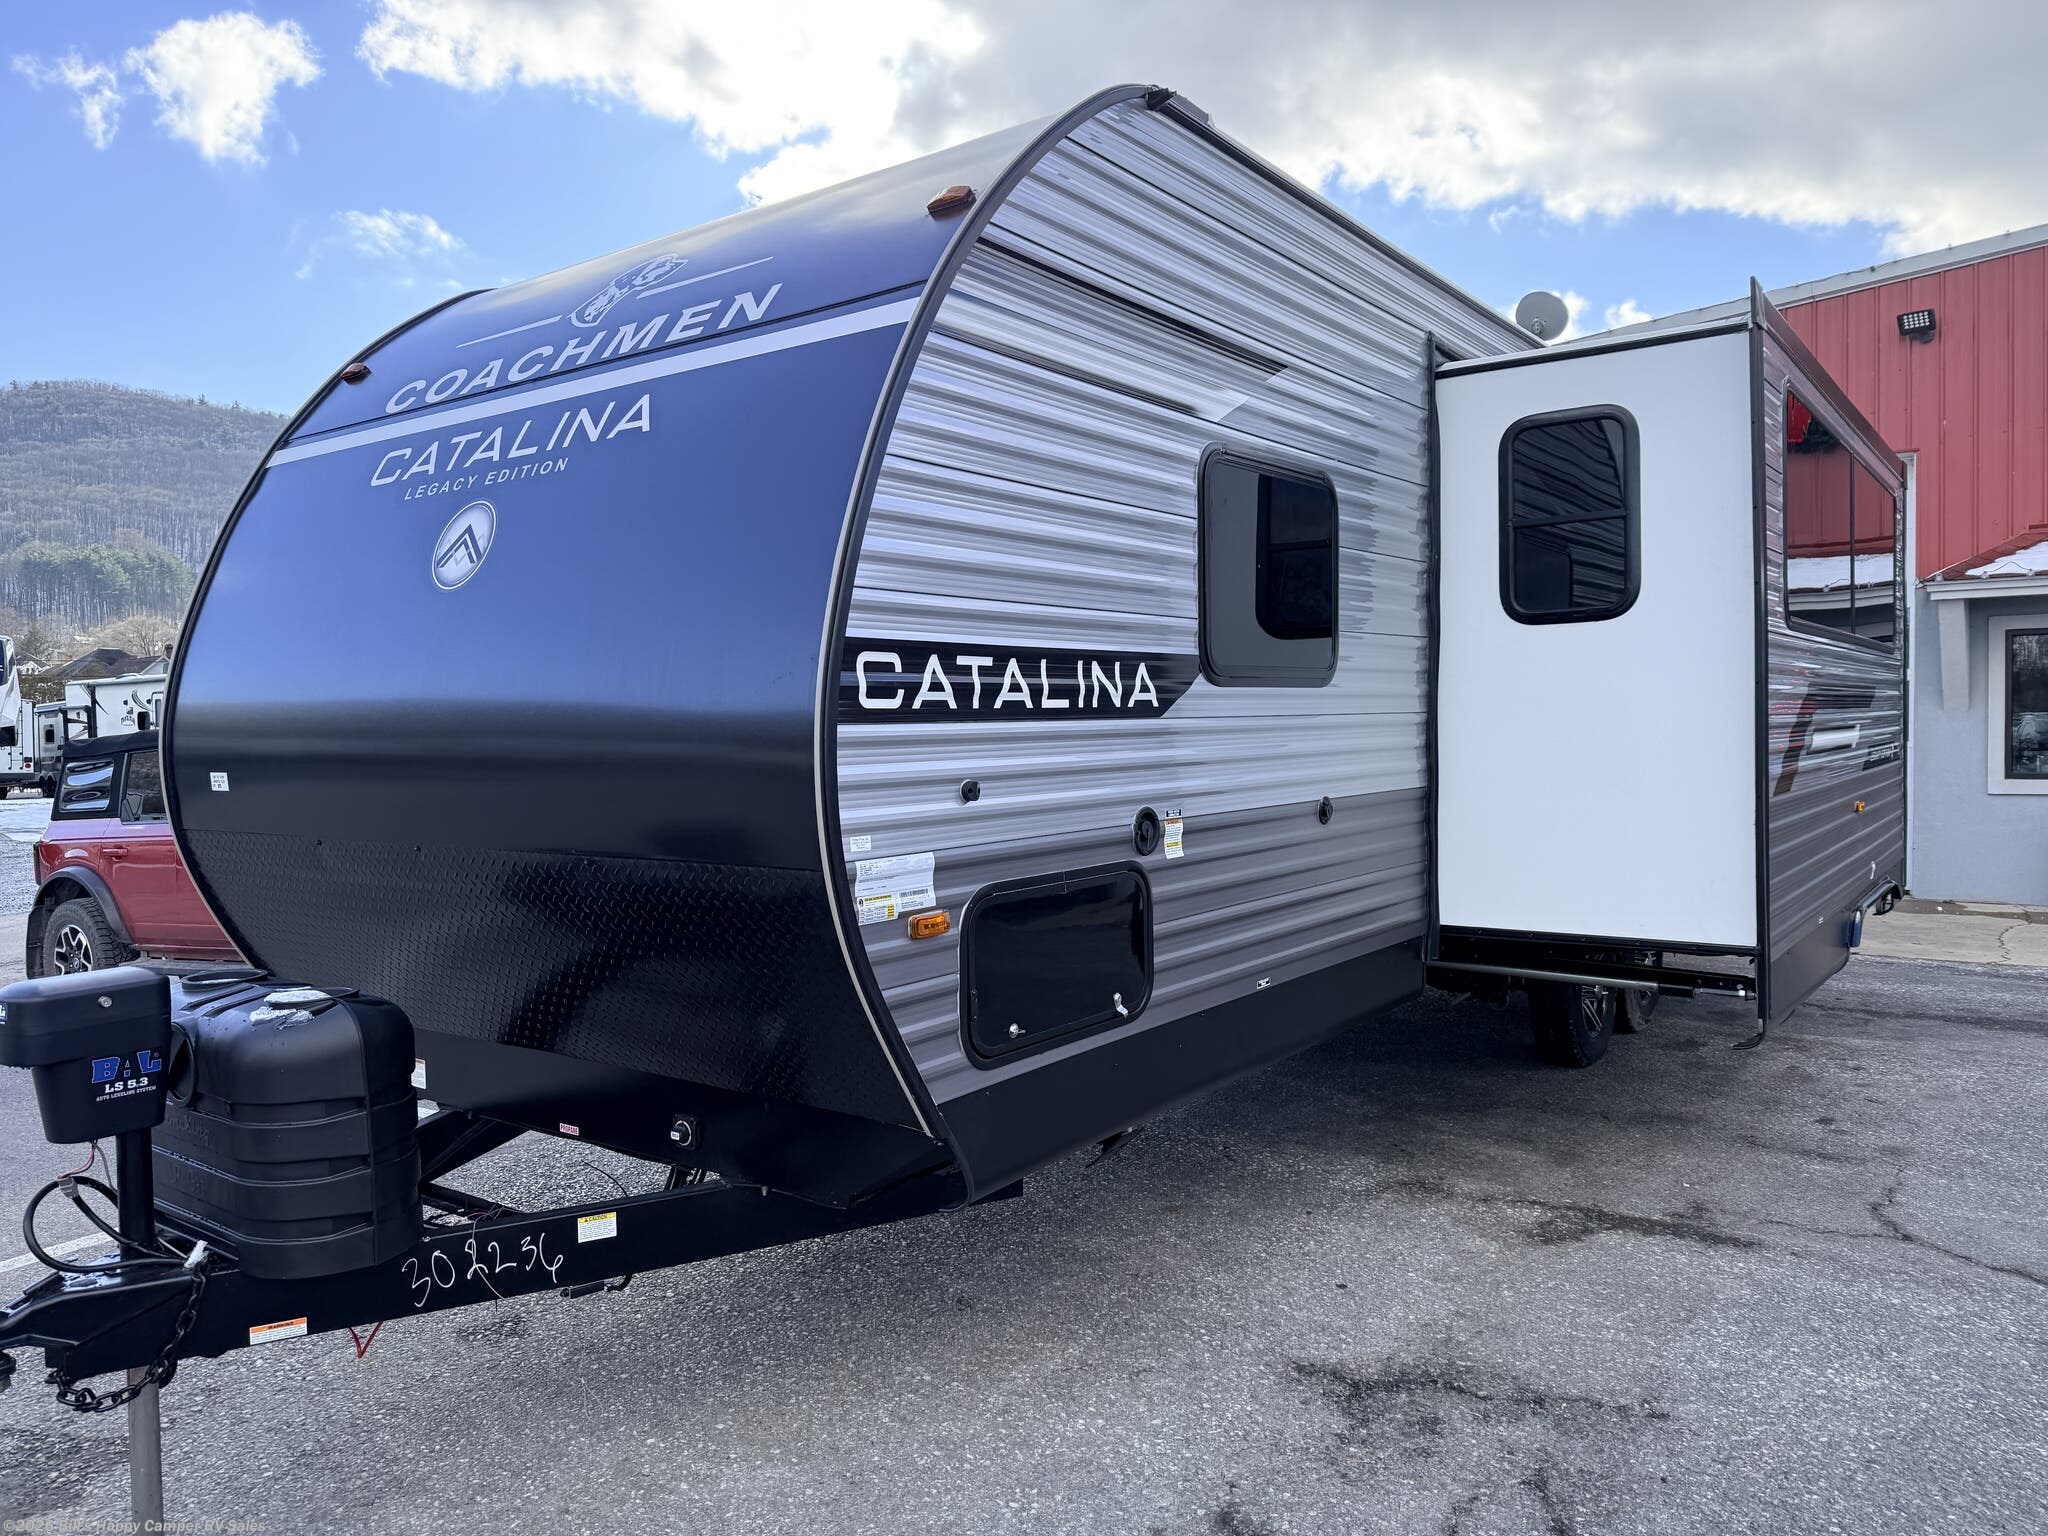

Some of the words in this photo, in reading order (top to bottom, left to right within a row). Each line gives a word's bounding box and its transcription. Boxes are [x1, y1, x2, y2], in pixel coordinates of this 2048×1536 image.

[385, 283, 782, 414] COACHMEN
[370, 394, 651, 487] CATALINA
[404, 474, 479, 501] LEGACY
[485, 457, 569, 485] EDITION
[856, 650, 1160, 709] CATALINA
[104, 1081, 124, 1093] LS
[127, 1076, 148, 1089] 5.3
[560, 1124, 578, 1135] PROPANE
